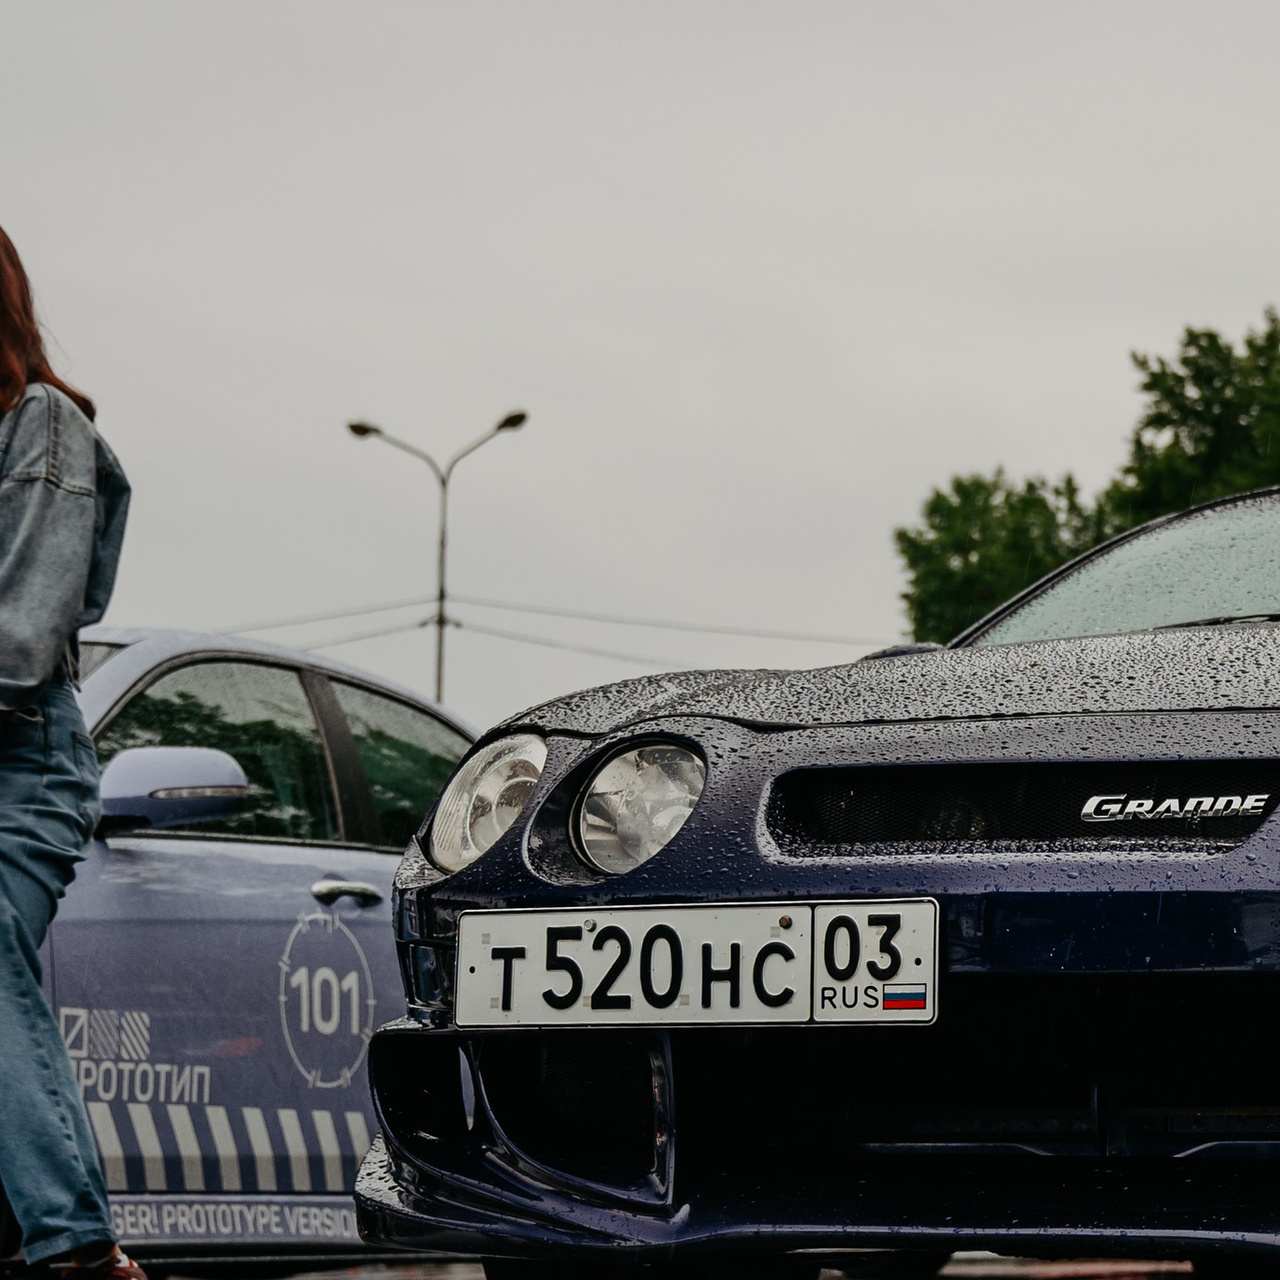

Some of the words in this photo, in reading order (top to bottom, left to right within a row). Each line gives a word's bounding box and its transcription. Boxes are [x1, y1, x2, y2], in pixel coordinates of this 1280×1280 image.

[823, 913, 902, 982] 03
[290, 967, 360, 1036] 101
[820, 984, 880, 1011] RUS
[111, 1203, 160, 1236] GER!
[162, 1204, 284, 1236] PROTOTYPE
[284, 1206, 358, 1238] VERSIO
